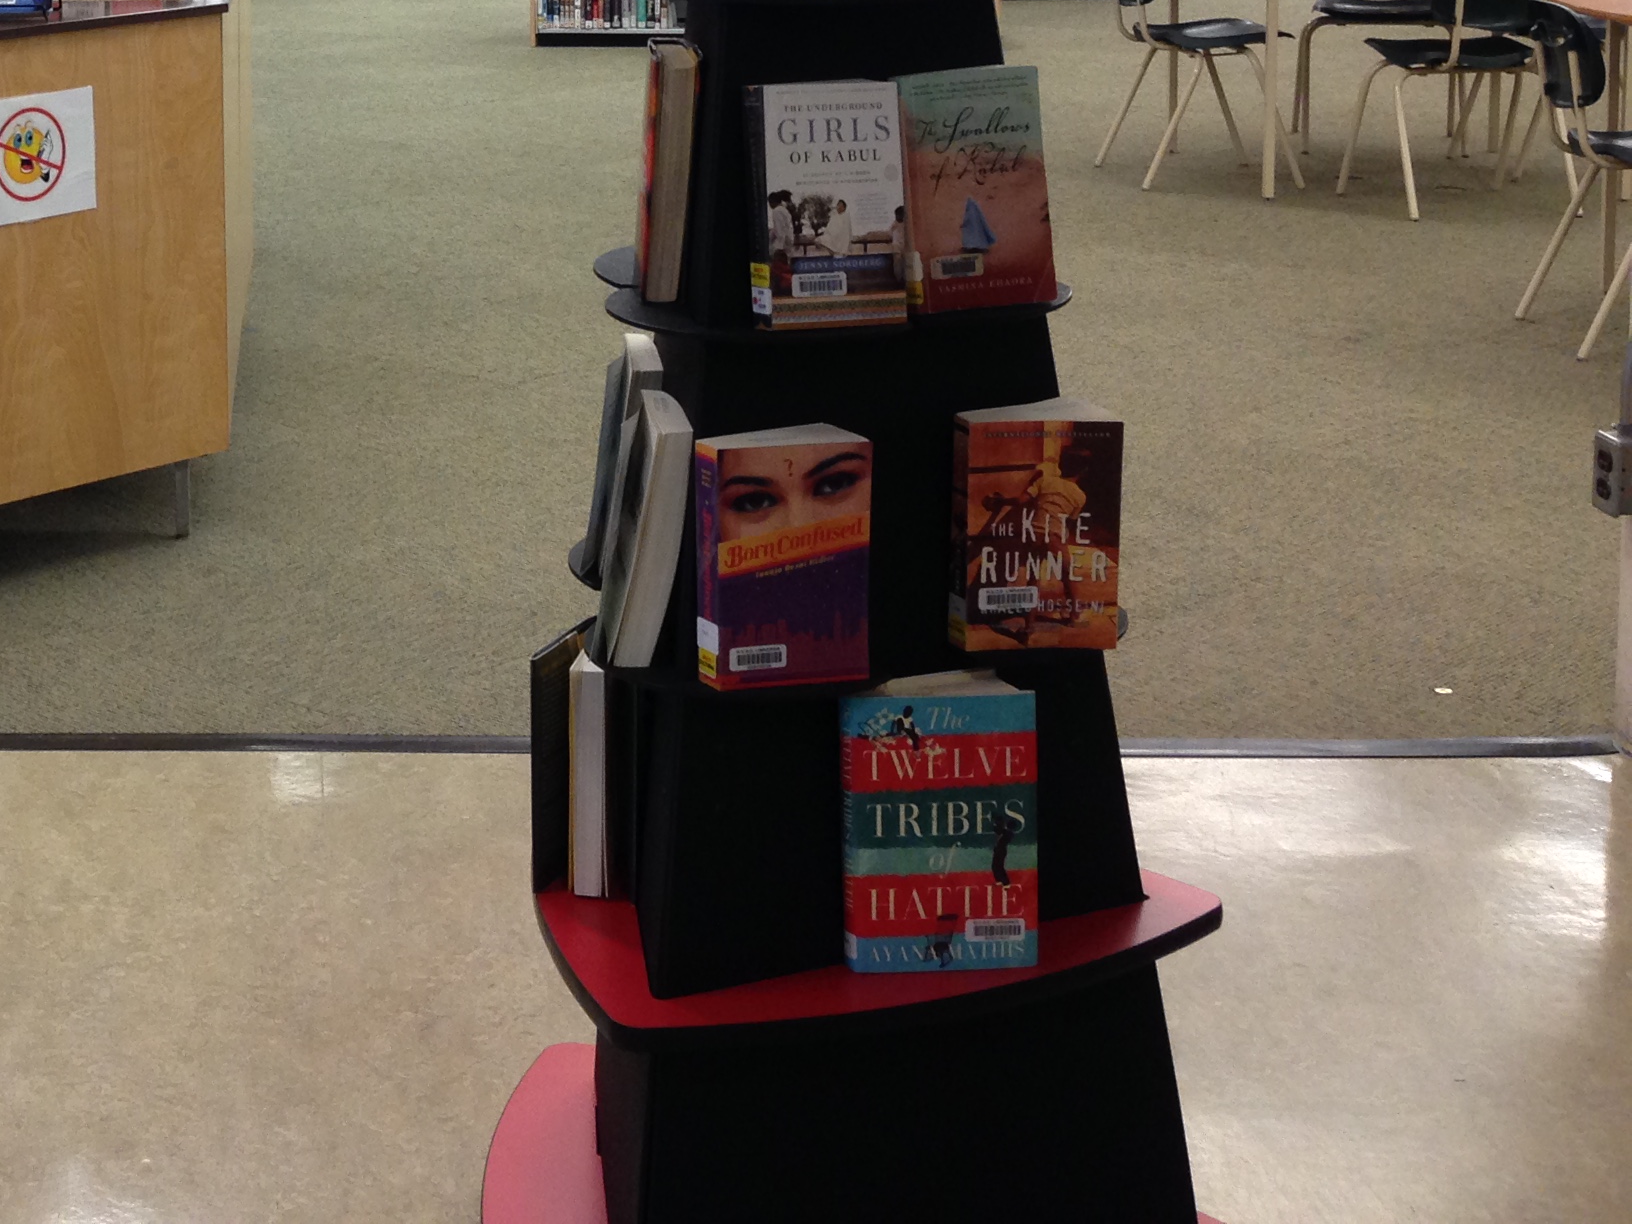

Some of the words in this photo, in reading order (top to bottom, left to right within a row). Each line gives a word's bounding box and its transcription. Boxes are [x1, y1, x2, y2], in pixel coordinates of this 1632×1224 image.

[784, 104, 802, 112] THE
[807, 102, 883, 112] UNDERGROUND
[777, 115, 891, 145] GIRLS
[935, 106, 1030, 154] Swallows
[790, 151, 811, 164] OF
[821, 149, 882, 163] KABUL
[954, 142, 1027, 185] Kabul
[798, 260, 829, 270] JENNY
[724, 543, 775, 568] Born
[776, 517, 864, 555] Confused
[990, 523, 1015, 537] THE
[1021, 507, 1092, 544] KITE
[980, 546, 1107, 584] RUNNER
[1037, 599, 1104, 613] HOSSEINI
[926, 706, 971, 731] The
[863, 745, 1027, 782] TWELVE
[866, 799, 1026, 838] TRIBES
[928, 841, 962, 879] of
[869, 883, 1025, 921] HATTIE
